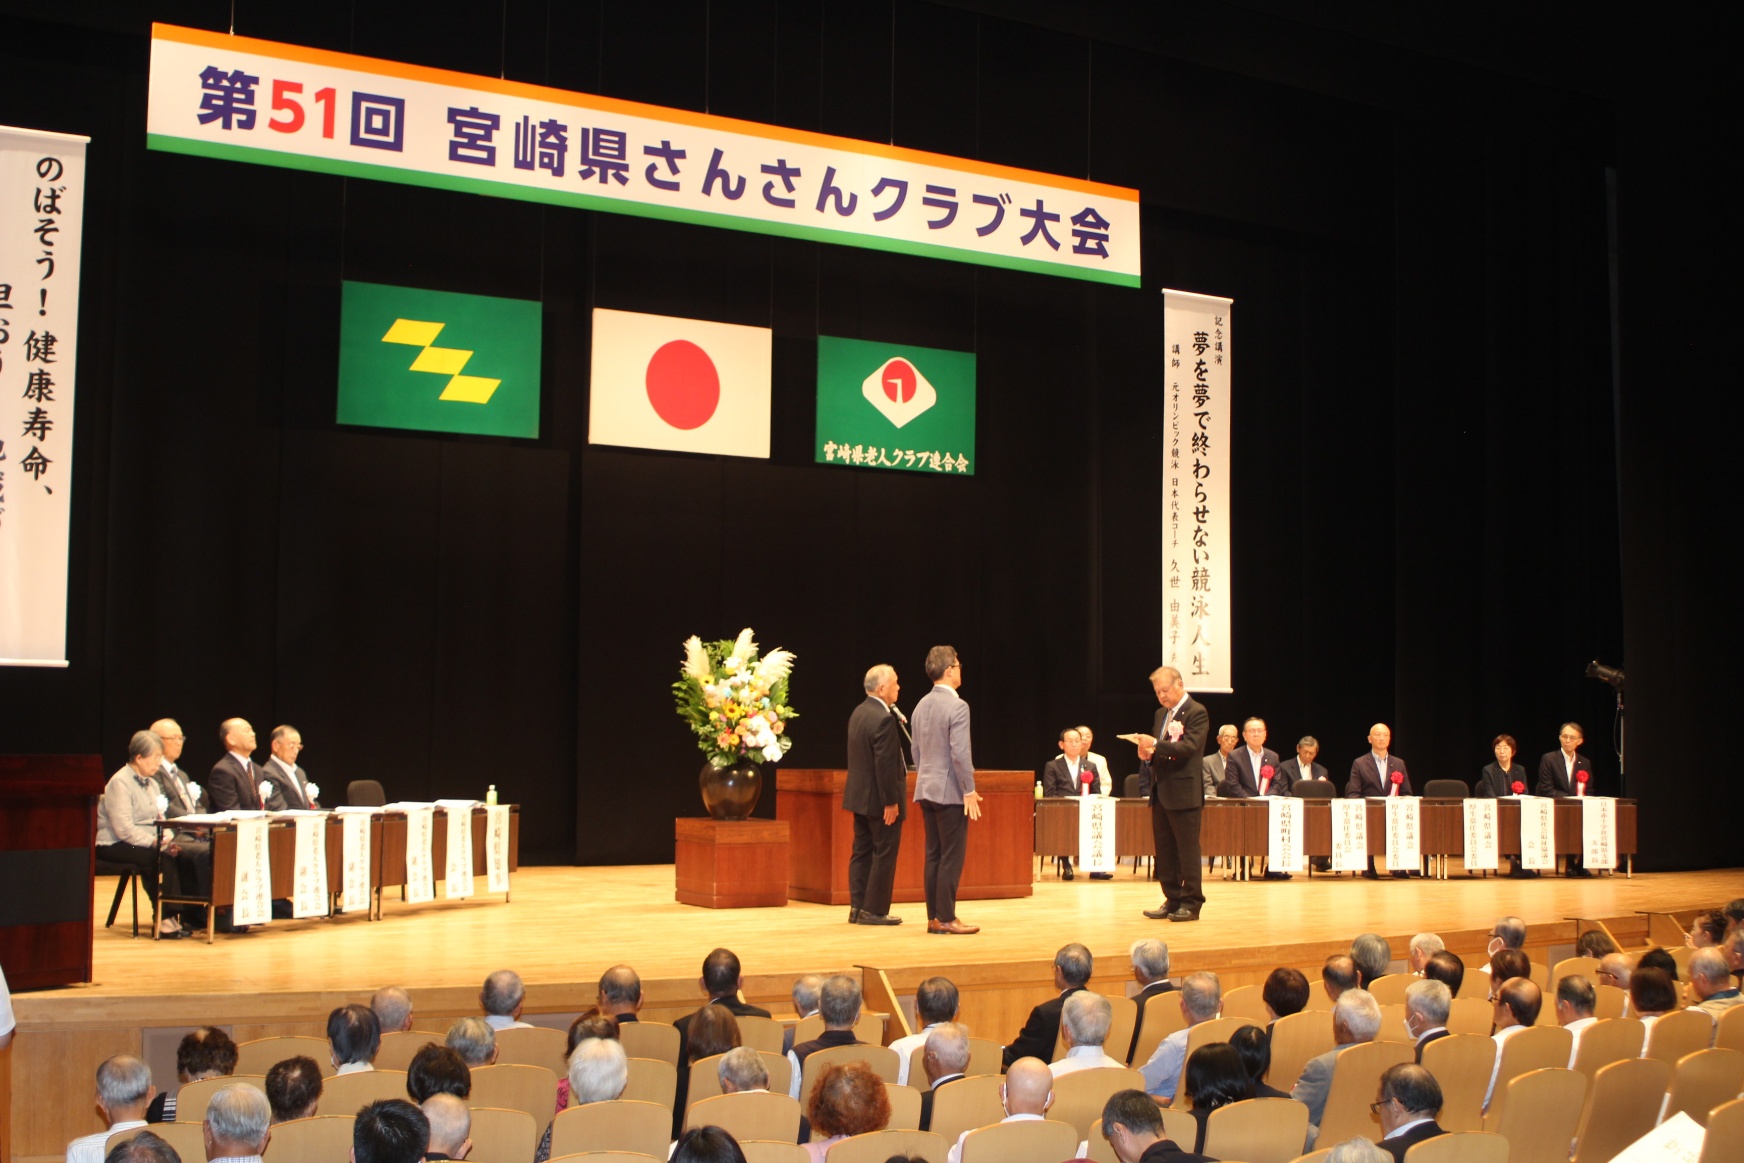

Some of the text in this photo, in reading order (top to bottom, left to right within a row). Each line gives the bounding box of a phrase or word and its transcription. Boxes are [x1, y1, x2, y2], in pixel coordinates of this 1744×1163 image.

[197, 65, 1110, 260] 第51回 宮崎県さんさんクラブ大会
[1171, 343, 1180, 370] 講師
[1214, 315, 1223, 366] 記念講演
[1170, 382, 1180, 470] 元オリンピック競泳
[823, 440, 969, 472] 宮崎県老人クラブ連合会
[1170, 477, 1180, 549] 日本代表コーチ
[1191, 331, 1211, 676] 夢を夢で終わらせない競泳人生
[1169, 558, 1180, 589] 久世
[1091, 803, 1103, 867] 宮崎県議会議長
[1281, 803, 1291, 867] 宮崎県町村会会長
[1343, 804, 1351, 853] 厚生常任委員会
[1355, 803, 1363, 849] 宮崎県議会
[1391, 804, 1399, 867] 厚生常任委員会委員
[1406, 803, 1414, 849] 宮崎県議会
[1469, 804, 1477, 867] 厚生常任委員会委員
[1484, 803, 1492, 849] 宮崎県議会
